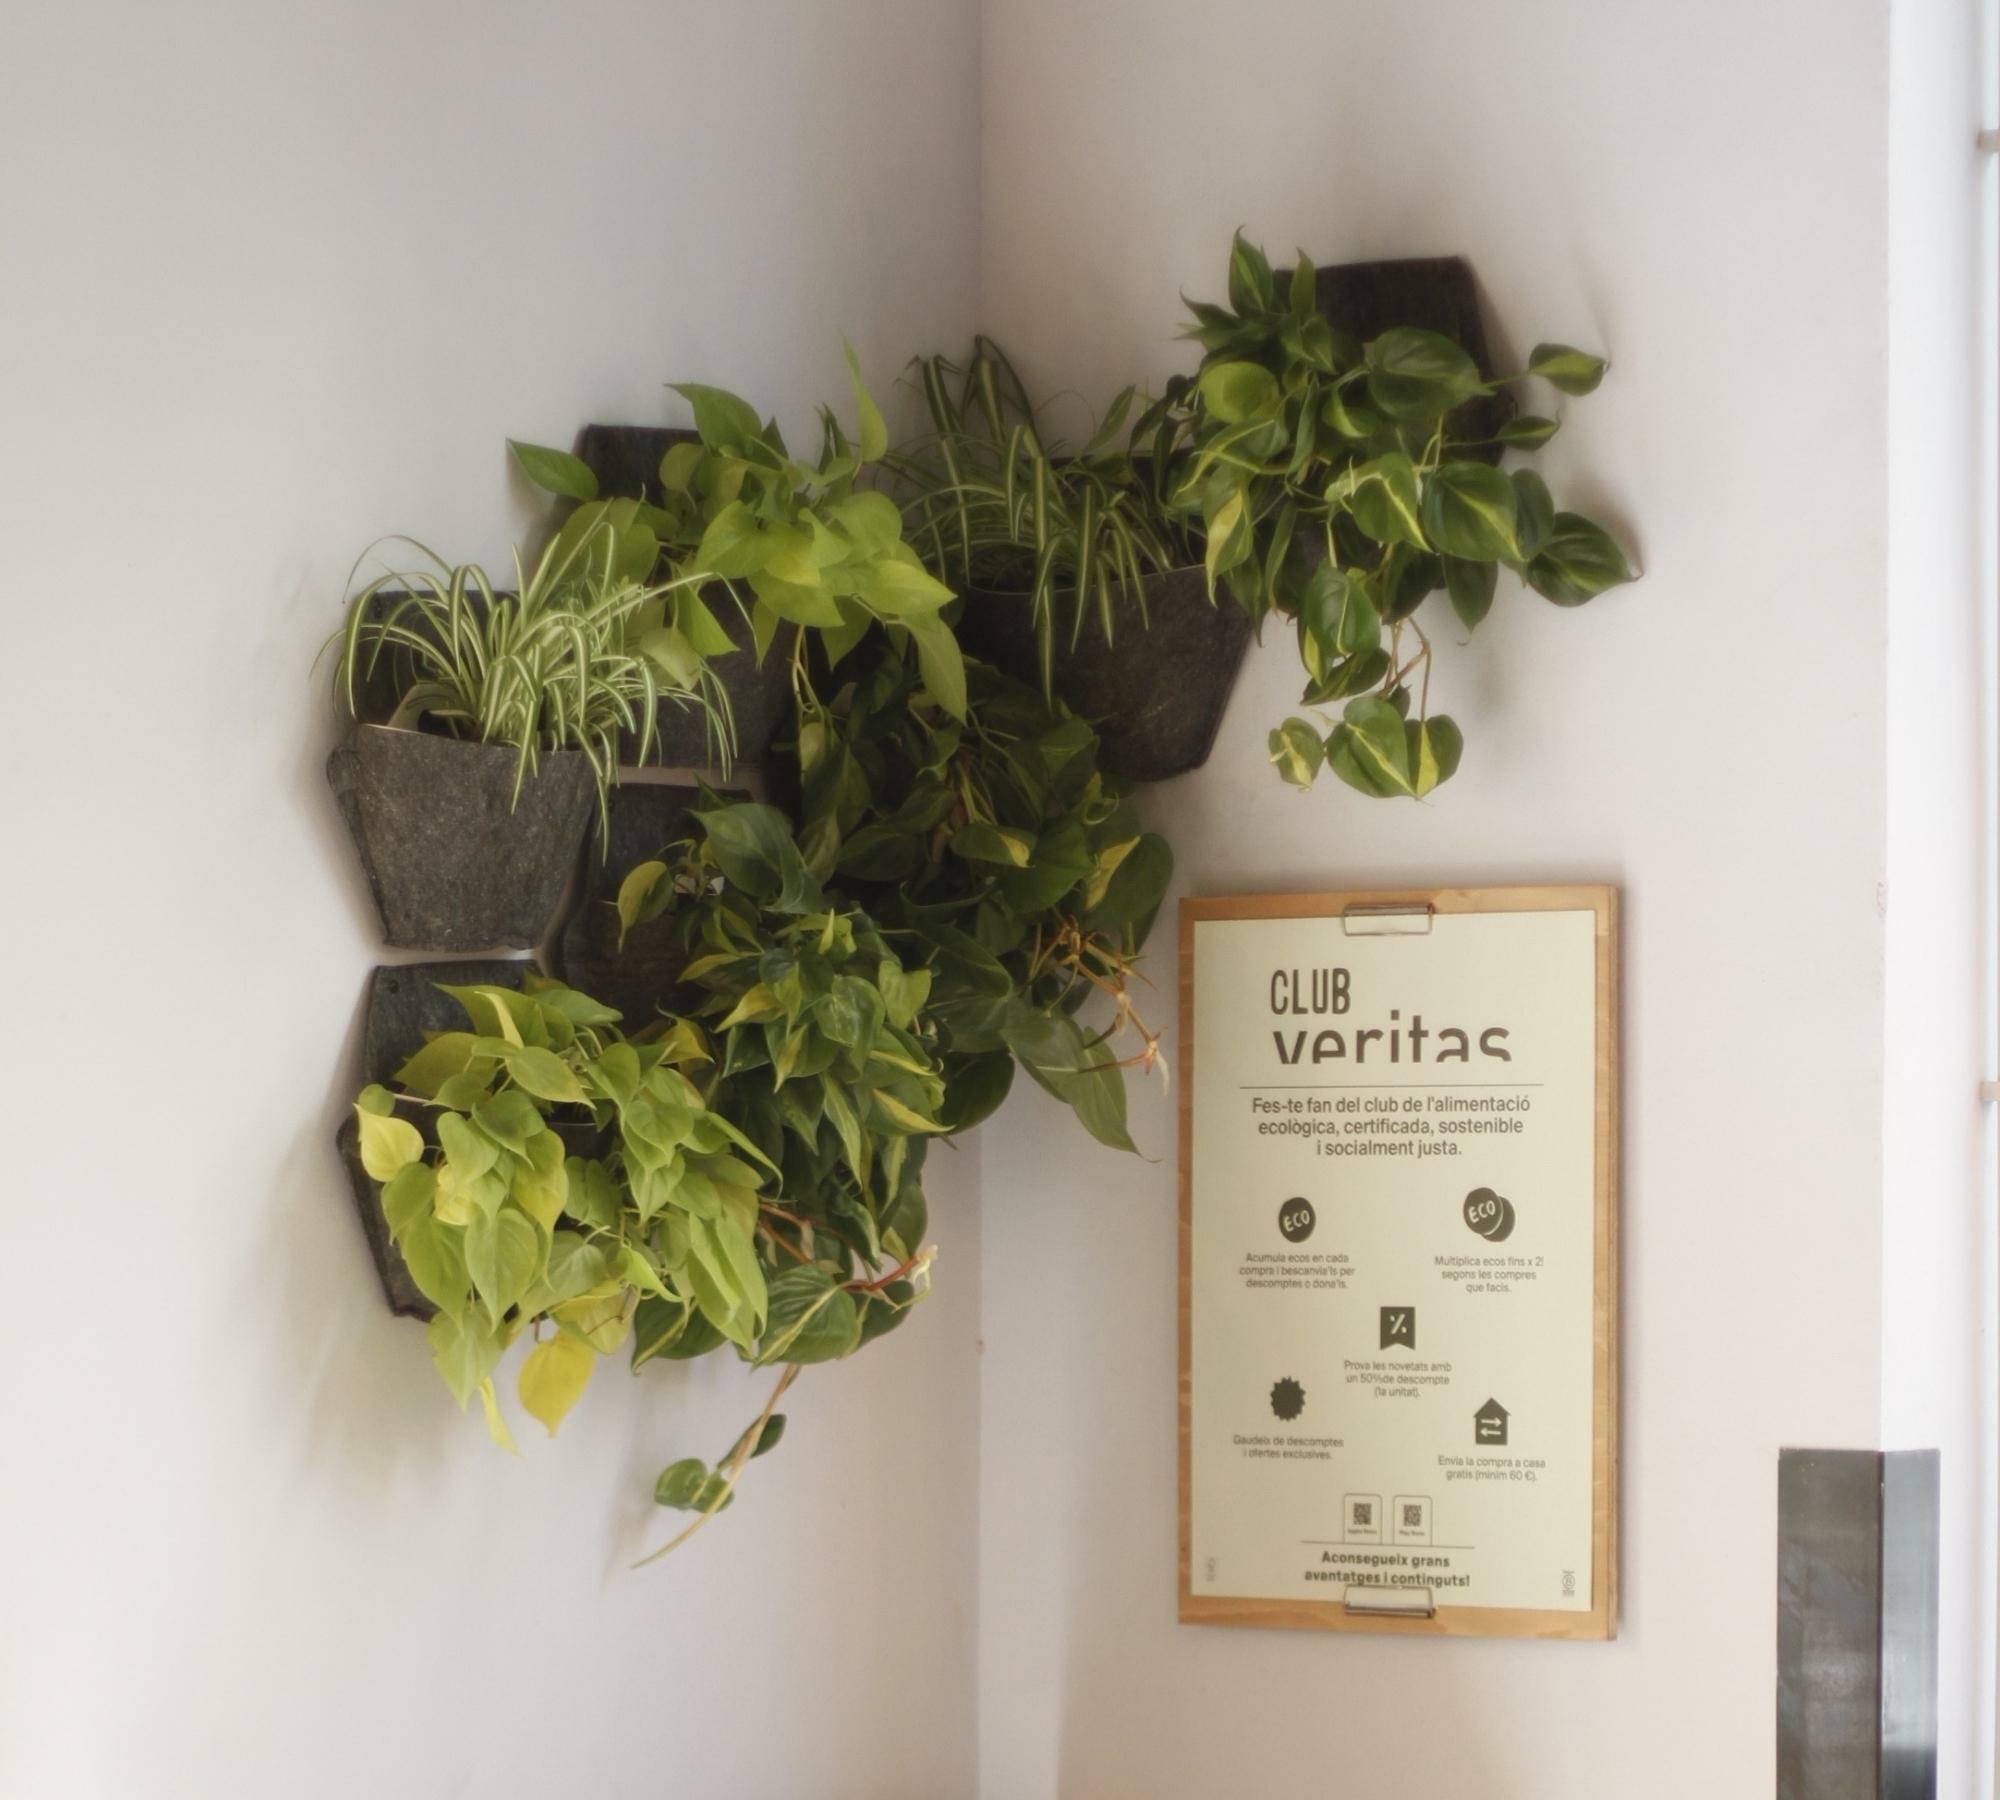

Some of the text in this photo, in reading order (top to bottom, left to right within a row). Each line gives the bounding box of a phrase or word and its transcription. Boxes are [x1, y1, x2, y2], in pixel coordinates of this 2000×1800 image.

[1270, 967, 1351, 1015] CLUB
[1272, 1009, 1512, 1065] veritas
[1252, 1095, 1531, 1114] Fes-te fan del club de l'alimentació
[1258, 1116, 1524, 1137] ecològica, certificada, sostenible
[1317, 1140, 1462, 1158] i socialment justa.
[1468, 1200, 1496, 1223] ECO
[1283, 1210, 1310, 1232] ECO
[1246, 1253, 1349, 1263] Acumula ecos en cada
[1434, 1256, 1481, 1267] Multiplica
[1483, 1257, 1505, 1267] ecos
[1508, 1256, 1525, 1267] fins
[1528, 1258, 1533, 1267] x
[1239, 1266, 1274, 1277] compra
[1340, 1267, 1355, 1277] per
[1441, 1270, 1537, 1281] segons les compres
[1246, 1279, 1302, 1289] descomptes
[1304, 1281, 1311, 1289] o
[1465, 1282, 1512, 1293] que facis.
[1344, 1360, 1452, 1372] Prova les novetats amb
[1346, 1374, 1359, 1384] un
[1397, 1374, 1450, 1386] descompte
[1232, 1434, 1344, 1448] Gaudeix de descomptes
[1248, 1448, 1281, 1458] ofertes
[1438, 1455, 1546, 1468] Envia la compra a casa
[1509, 1470, 1523, 1481] 60
[1321, 1550, 1450, 1569] Aconsegueix grans
[1304, 1569, 1470, 1588] avantatges i continguts!
